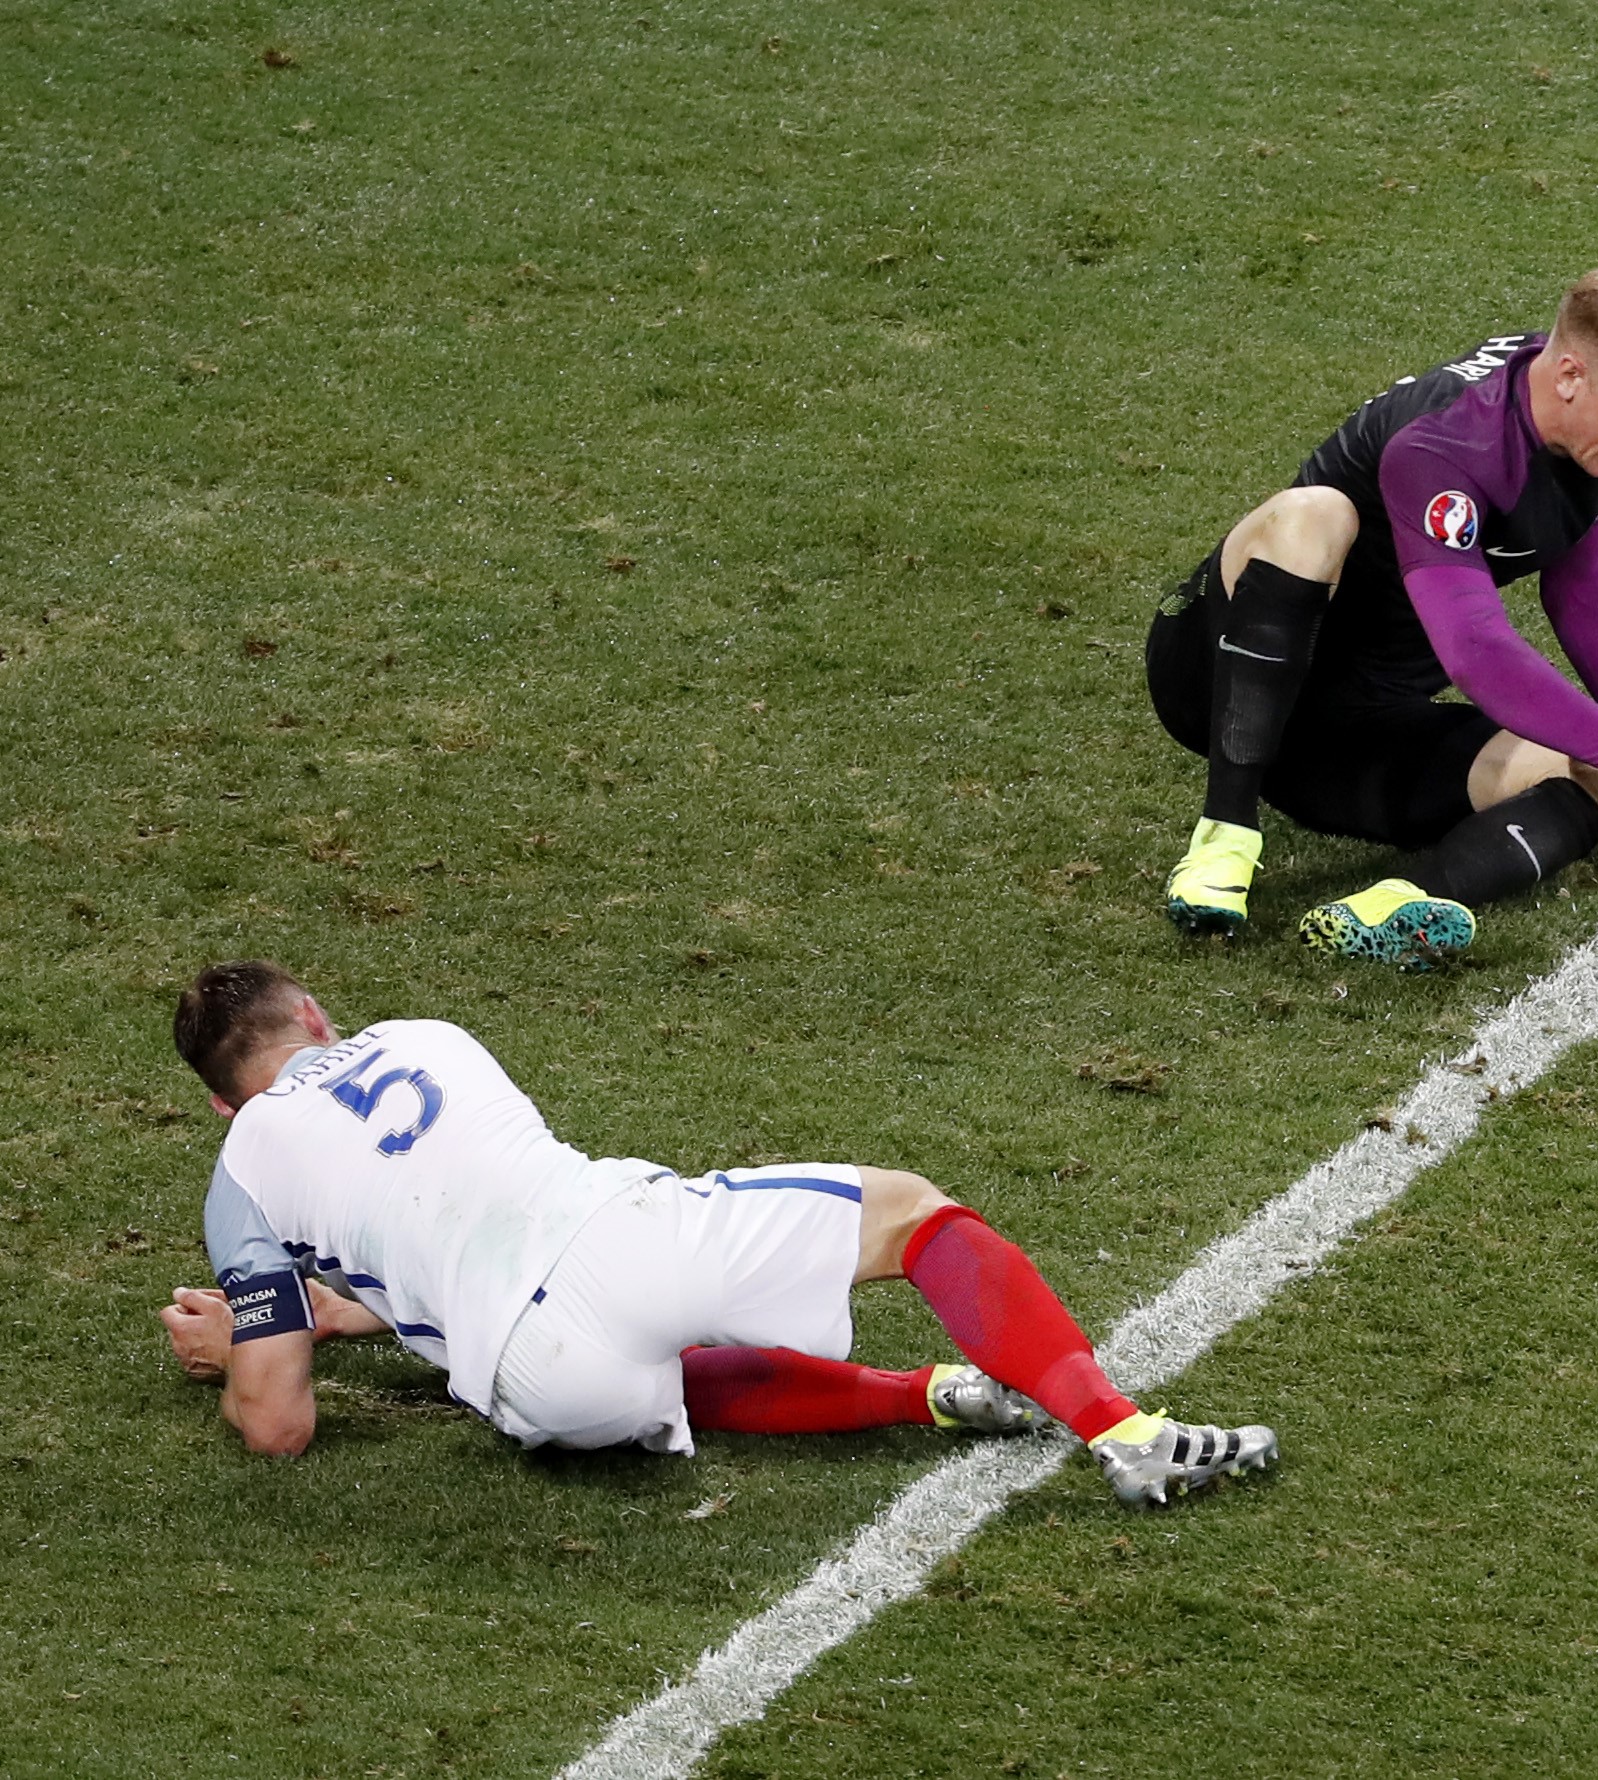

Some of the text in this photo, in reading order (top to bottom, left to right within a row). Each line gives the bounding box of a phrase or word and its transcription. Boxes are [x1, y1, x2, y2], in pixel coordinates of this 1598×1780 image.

[1442, 335, 1525, 381] HART
[263, 1031, 390, 1096] CAHILL
[318, 1048, 447, 1158] 5
[234, 1308, 272, 1327] ESPECT
[237, 1288, 277, 1306] RACISM
